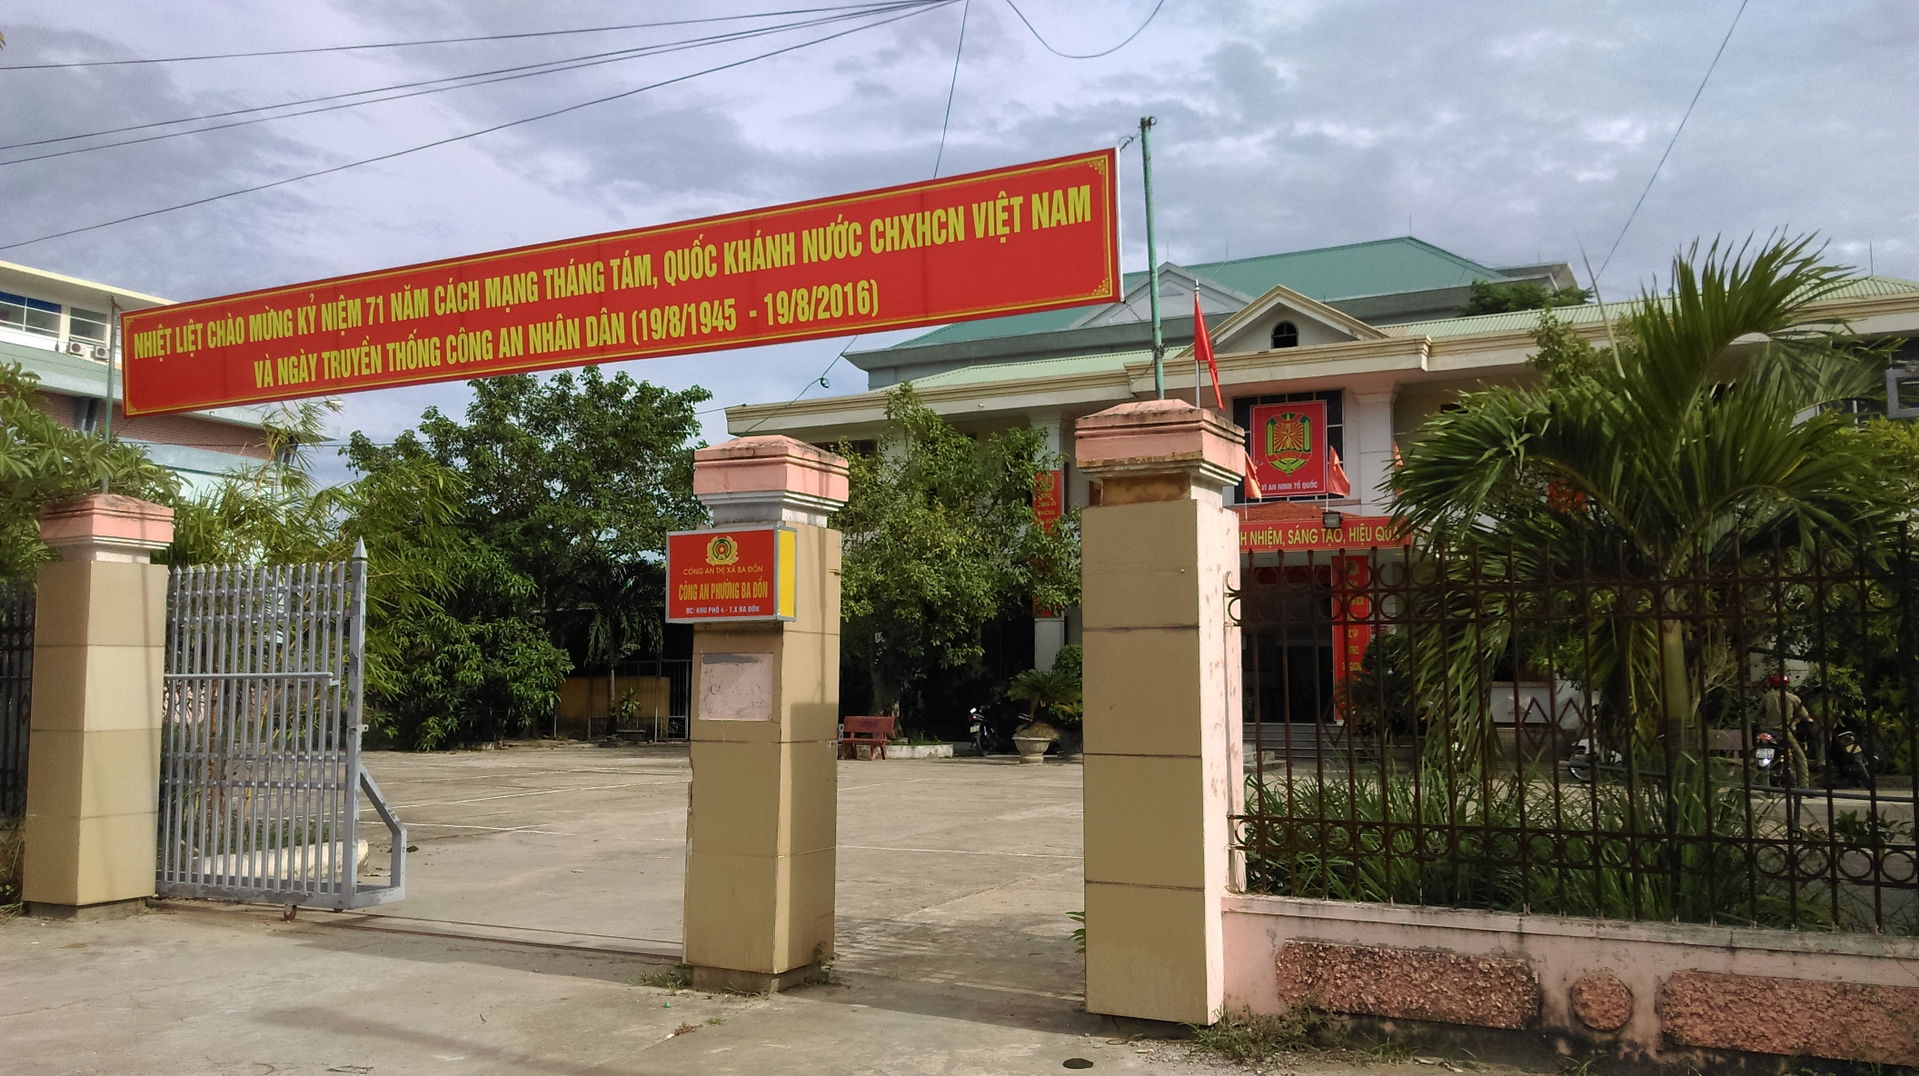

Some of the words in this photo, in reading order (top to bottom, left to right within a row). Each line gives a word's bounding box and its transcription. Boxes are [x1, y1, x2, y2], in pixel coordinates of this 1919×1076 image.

[134, 323, 172, 362] NHIỆT
[175, 319, 203, 357] LIỆT
[207, 312, 245, 349] CHÀO
[249, 305, 293, 343] MỪNG
[297, 292, 317, 335] KỶ
[321, 294, 362, 336] NIỆM
[366, 295, 384, 326] 71
[390, 284, 429, 322] NĂM
[434, 277, 479, 316] CÁCH
[485, 271, 538, 313] MẠNG
[543, 258, 605, 299] THÁNG
[609, 250, 658, 290] TÁM,
[663, 234, 718, 287] QUỐC
[723, 230, 796, 275] KHÁNH
[801, 214, 863, 265] NƯỚC
[869, 205, 965, 255] CHXHCN
[971, 190, 1024, 244] VIỆT
[1031, 184, 1092, 231] NAM
[254, 356, 274, 389] VÀ
[277, 350, 317, 386] NGÀY
[321, 335, 382, 380] TRUYỀN
[386, 328, 441, 372] THỐNG
[445, 326, 493, 365] CÔNG
[498, 325, 524, 359] AN
[528, 312, 580, 355] NHÂN
[585, 307, 626, 348] DÂN
[631, 298, 737, 346] (19/8/1945
[749, 310, 757, 318] -
[763, 279, 879, 326] 19/8/2016)
[1250, 526, 1285, 548] NHIỆM,
[1288, 524, 1318, 544] SÁNG
[1349, 522, 1372, 546] HIỆU
[705, 566, 715, 574] AN
[679, 581, 698, 600] CÔNG
[700, 584, 710, 600] AN
[741, 582, 751, 599] BA
